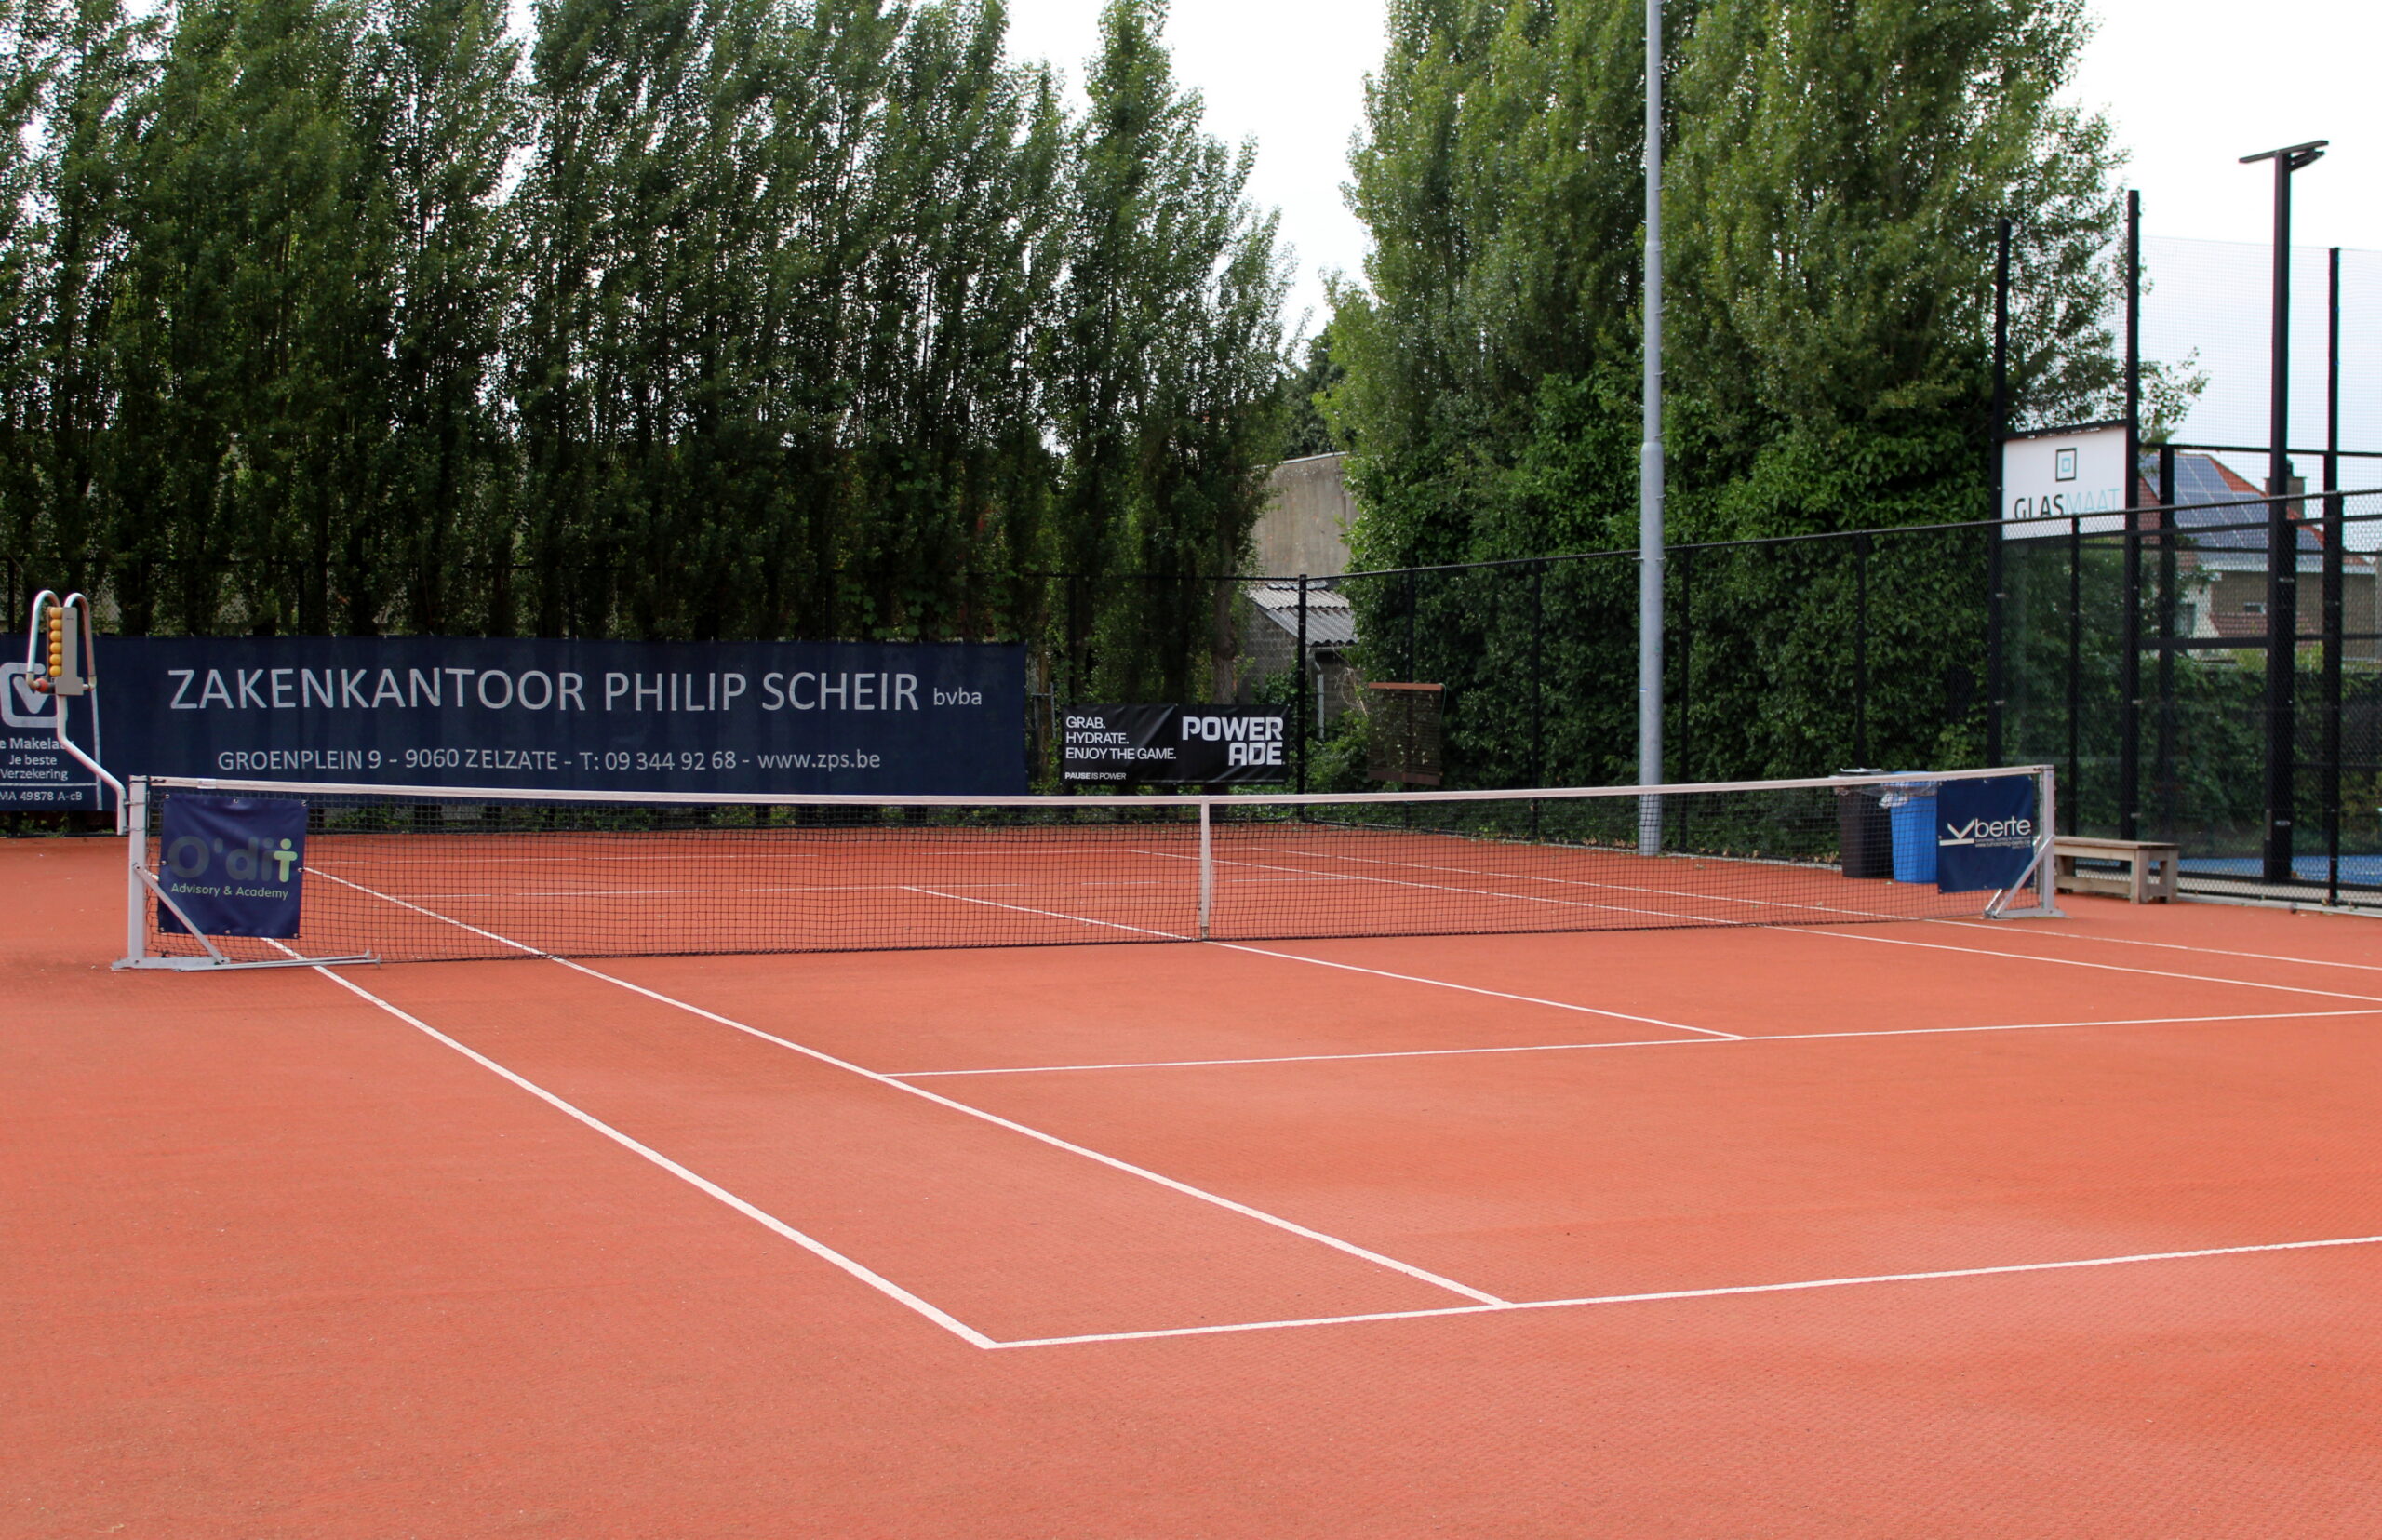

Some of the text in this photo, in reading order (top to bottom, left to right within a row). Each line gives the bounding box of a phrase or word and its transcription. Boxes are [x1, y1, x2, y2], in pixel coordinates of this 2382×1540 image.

[2014, 488, 2121, 519] GLASMAAT
[167, 667, 983, 711] ZAKENKANTOOR PHILIP SCHEIR bvba
[1065, 716, 1105, 730] GRAB.
[1182, 716, 1284, 741] POWER
[0, 737, 74, 750] e Makela
[1065, 731, 1130, 744] HYDRATE.
[1065, 747, 1177, 759] ENJOY THE GAME.
[1228, 742, 1282, 766] ADE
[8, 754, 58, 766] Je beste
[218, 750, 362, 770] GROENPLEIN
[368, 750, 381, 769] 9
[405, 748, 460, 768] 9060
[465, 749, 558, 770] ZELZATE
[636, 752, 676, 770] 344
[680, 752, 706, 770] 92
[712, 750, 737, 770] 68
[757, 748, 881, 772] www.zps.be
[0, 769, 69, 782] Verzekering
[1099, 772, 1127, 781] POWER
[0, 791, 17, 801] MA
[20, 791, 54, 801] 49878
[170, 883, 289, 901] Advisory & Academy
